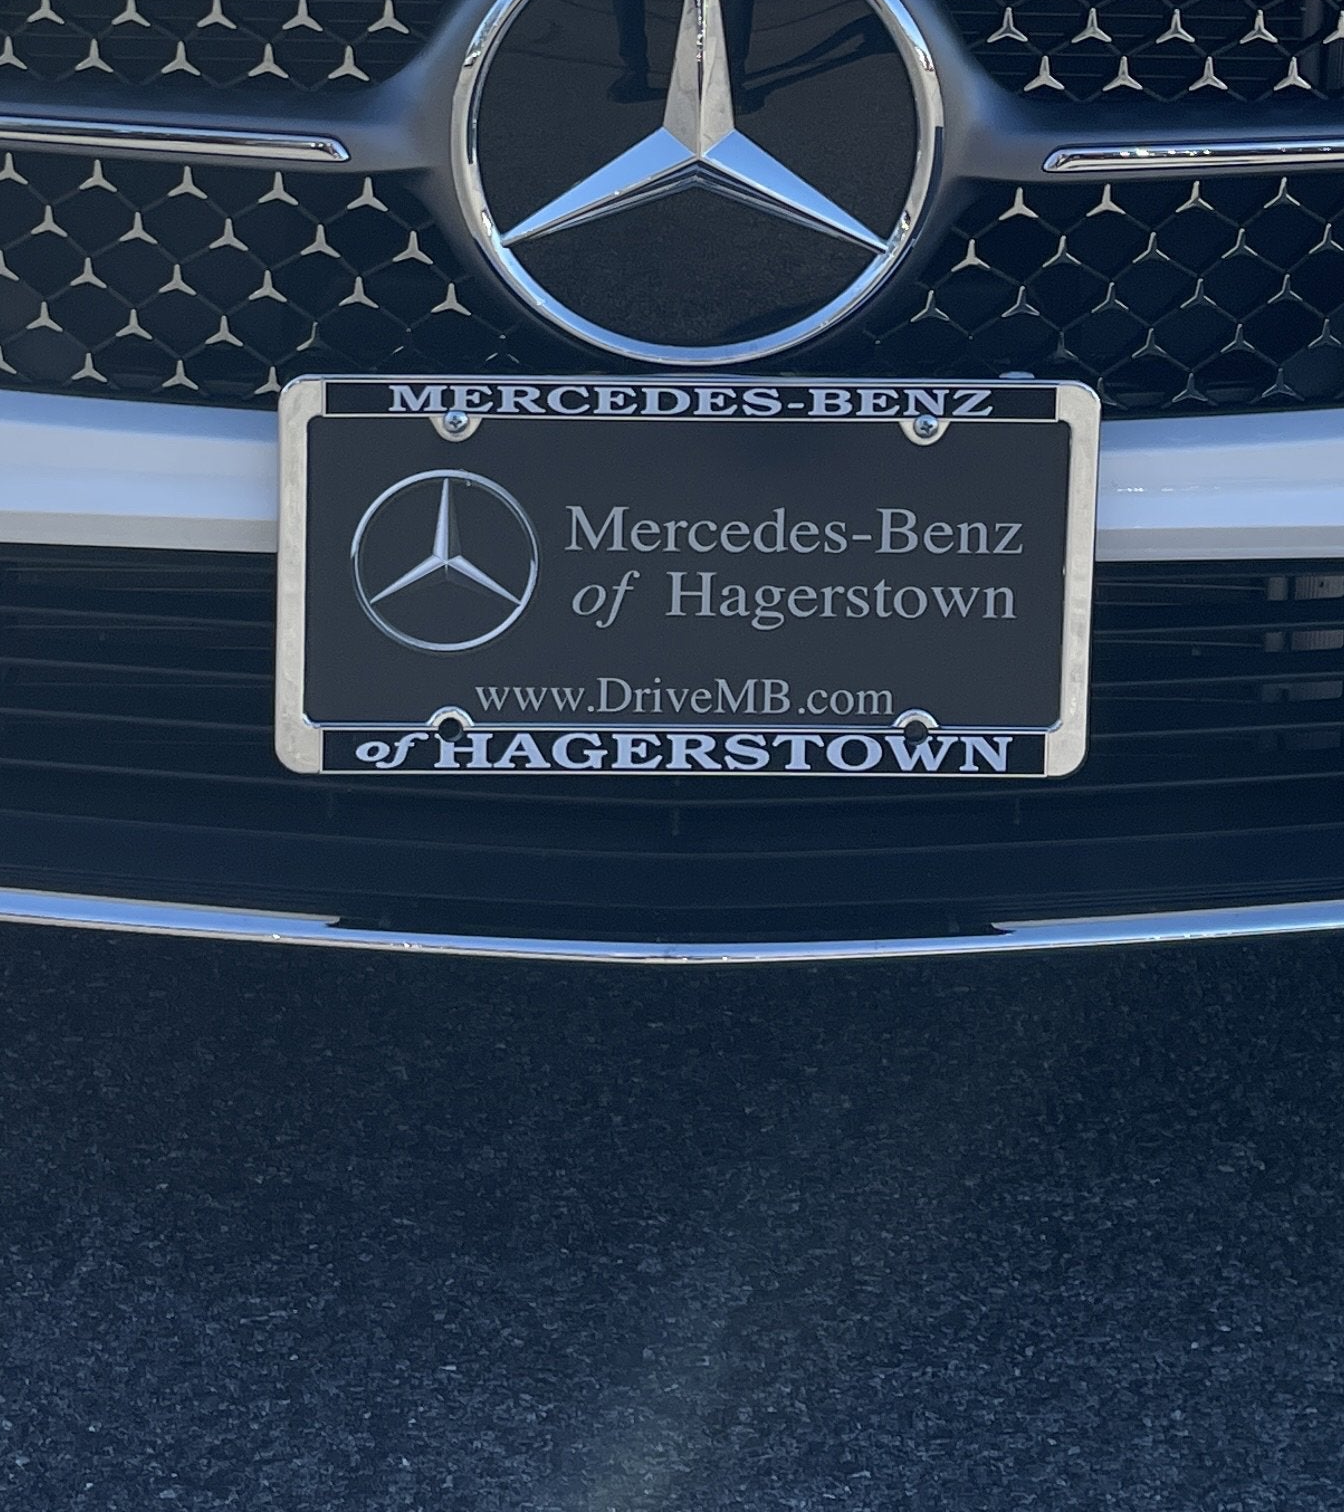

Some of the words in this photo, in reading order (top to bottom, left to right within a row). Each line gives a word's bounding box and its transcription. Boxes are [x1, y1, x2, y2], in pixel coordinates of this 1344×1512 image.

[388, 384, 994, 418] MERCEDES-BENZ
[564, 505, 1024, 556] Mercedes-Benz
[570, 571, 639, 627] of
[666, 572, 1017, 630] Hagerstown
[474, 677, 895, 716] www.DriveMB.com
[355, 732, 430, 769] of
[433, 732, 1013, 772] HAGERSTOWN
